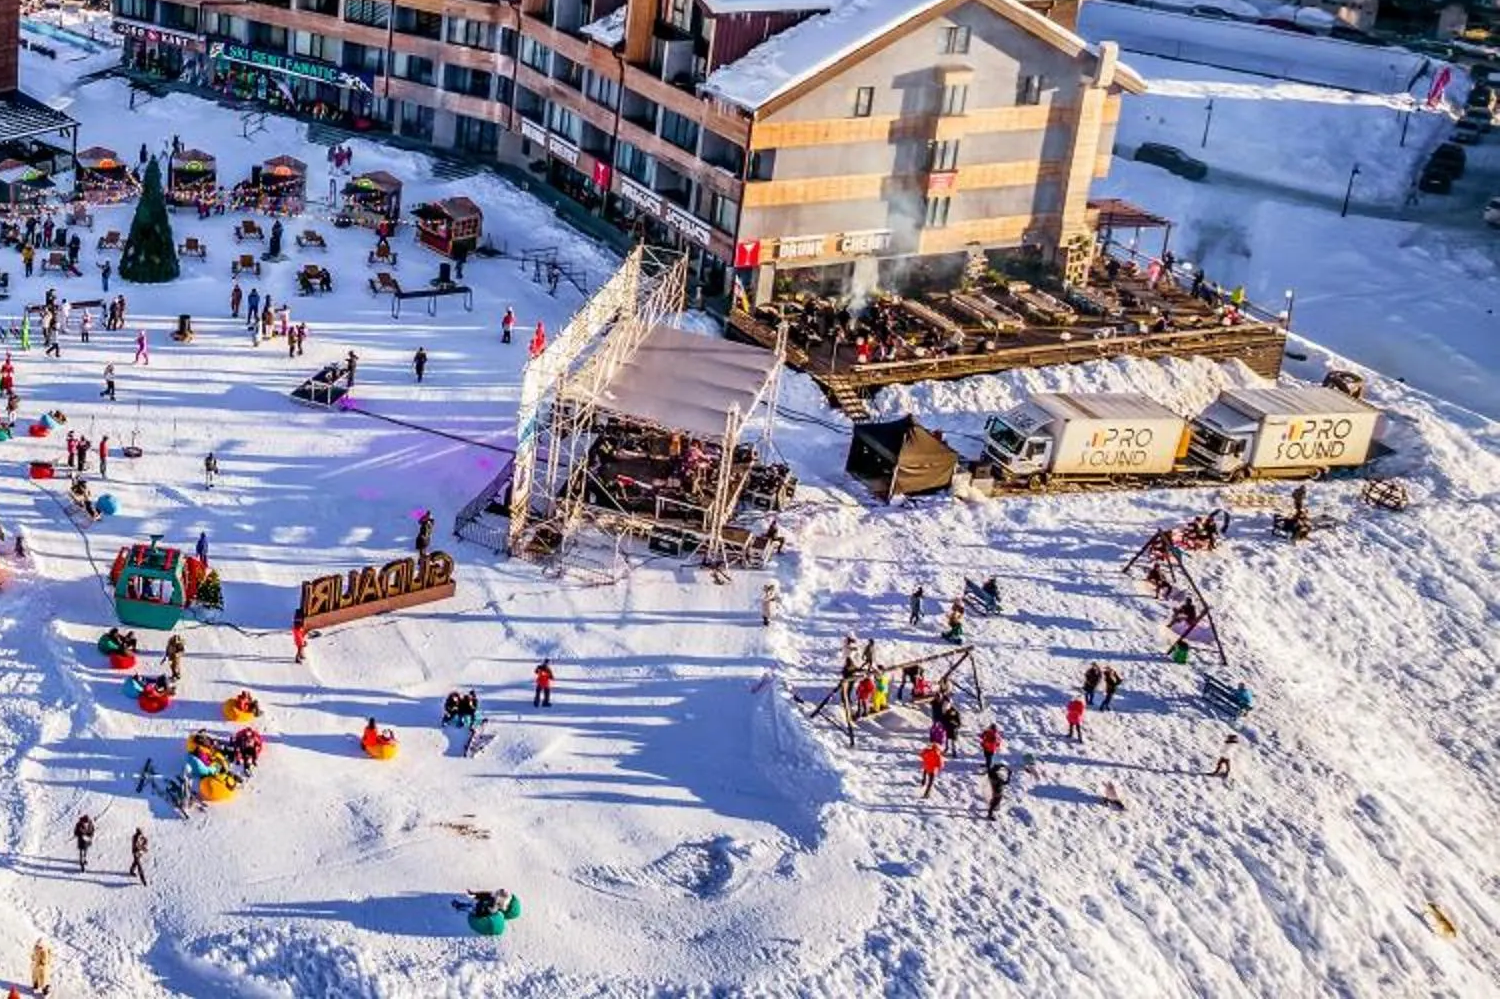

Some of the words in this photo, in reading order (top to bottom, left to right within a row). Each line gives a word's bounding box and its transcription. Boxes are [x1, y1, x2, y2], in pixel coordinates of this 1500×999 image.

[229, 44, 249, 60] SKI
[251, 50, 282, 68] RENT
[285, 58, 337, 83] FANATIC
[1104, 428, 1154, 448] PRO
[1300, 418, 1353, 440] PRO
[1079, 449, 1148, 467] SOUND
[1275, 440, 1346, 461] SOUND
